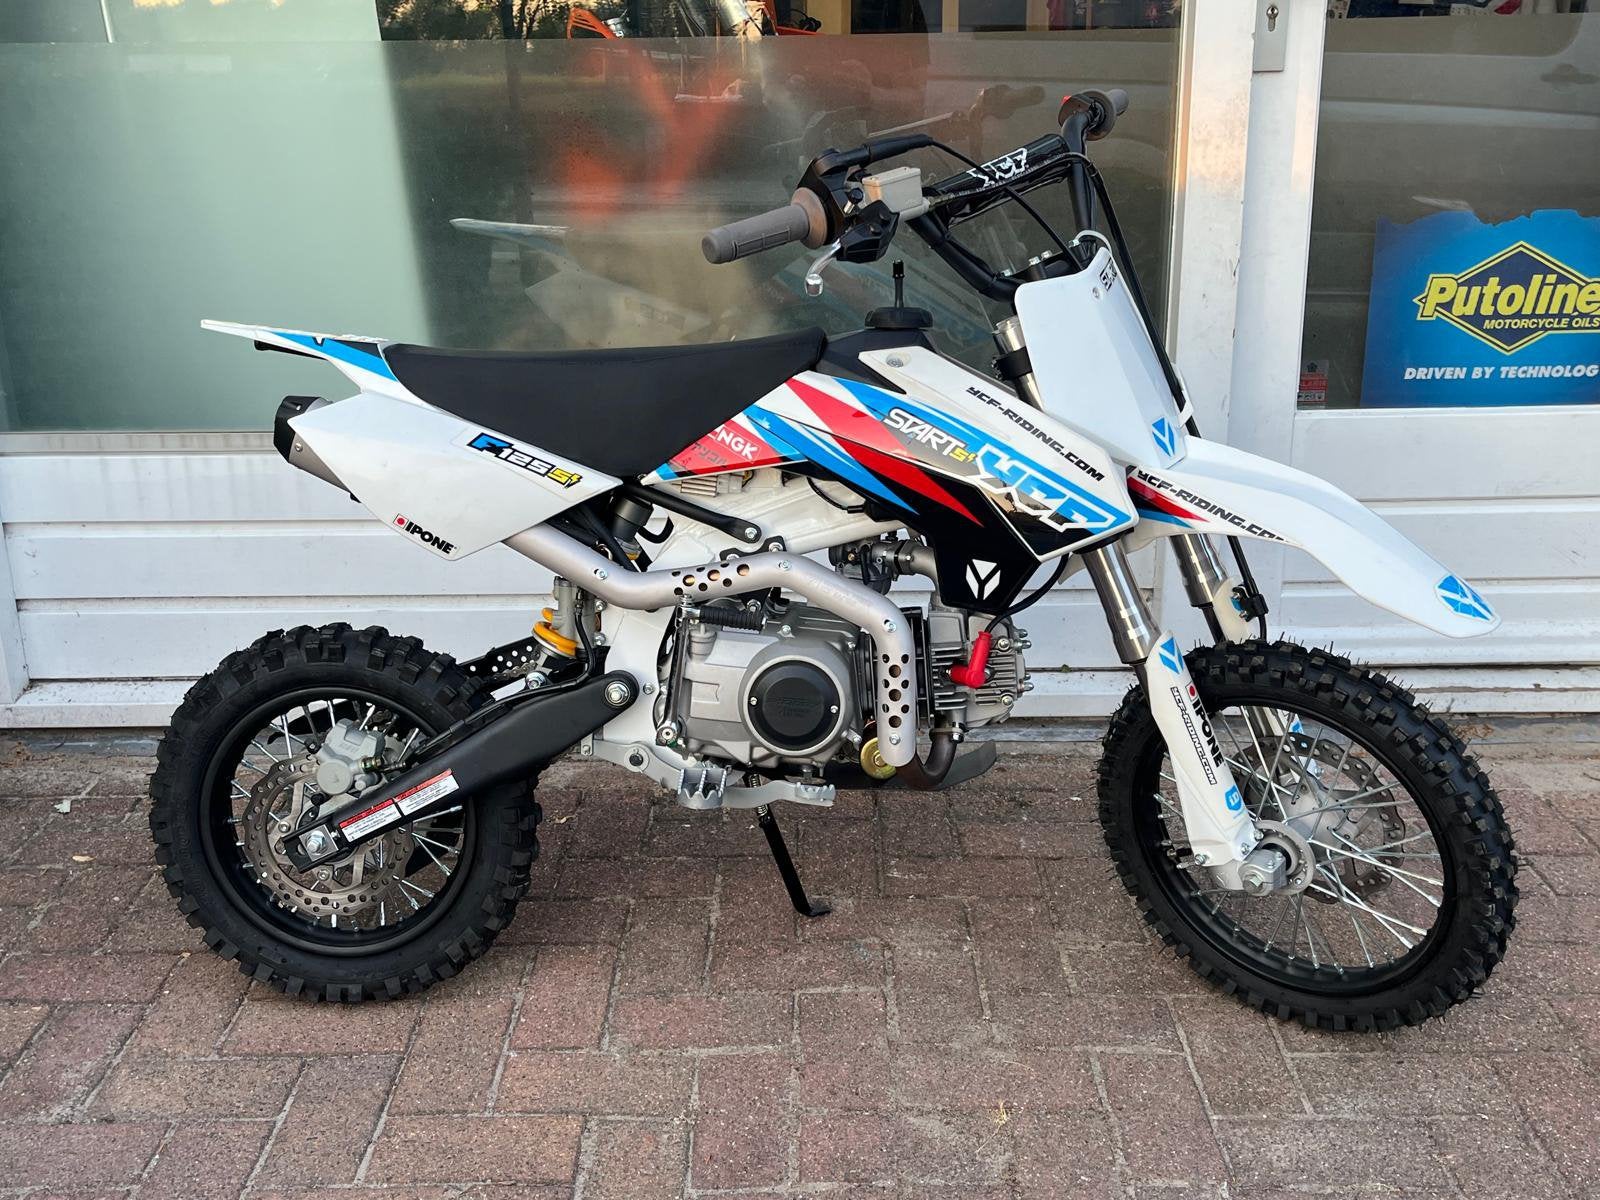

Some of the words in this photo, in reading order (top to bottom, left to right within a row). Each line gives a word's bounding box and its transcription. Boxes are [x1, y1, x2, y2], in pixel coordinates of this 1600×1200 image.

[1421, 274, 1600, 317] Putoline
[1483, 318, 1569, 330] MOTORCYCLE
[1571, 317, 1600, 328] OILS
[1404, 367, 1466, 380] DRIVEN
[1471, 367, 1495, 379] BY
[717, 426, 758, 460] NGK
[882, 408, 967, 456] START
[965, 386, 1106, 482] YCF-RIDING.COM
[1137, 470, 1288, 542] YCF-RIDING.CO
[405, 521, 455, 554] IPONE
[1170, 686, 1218, 785] YCF-RIDING.COM
[1192, 698, 1225, 768] IPONE
